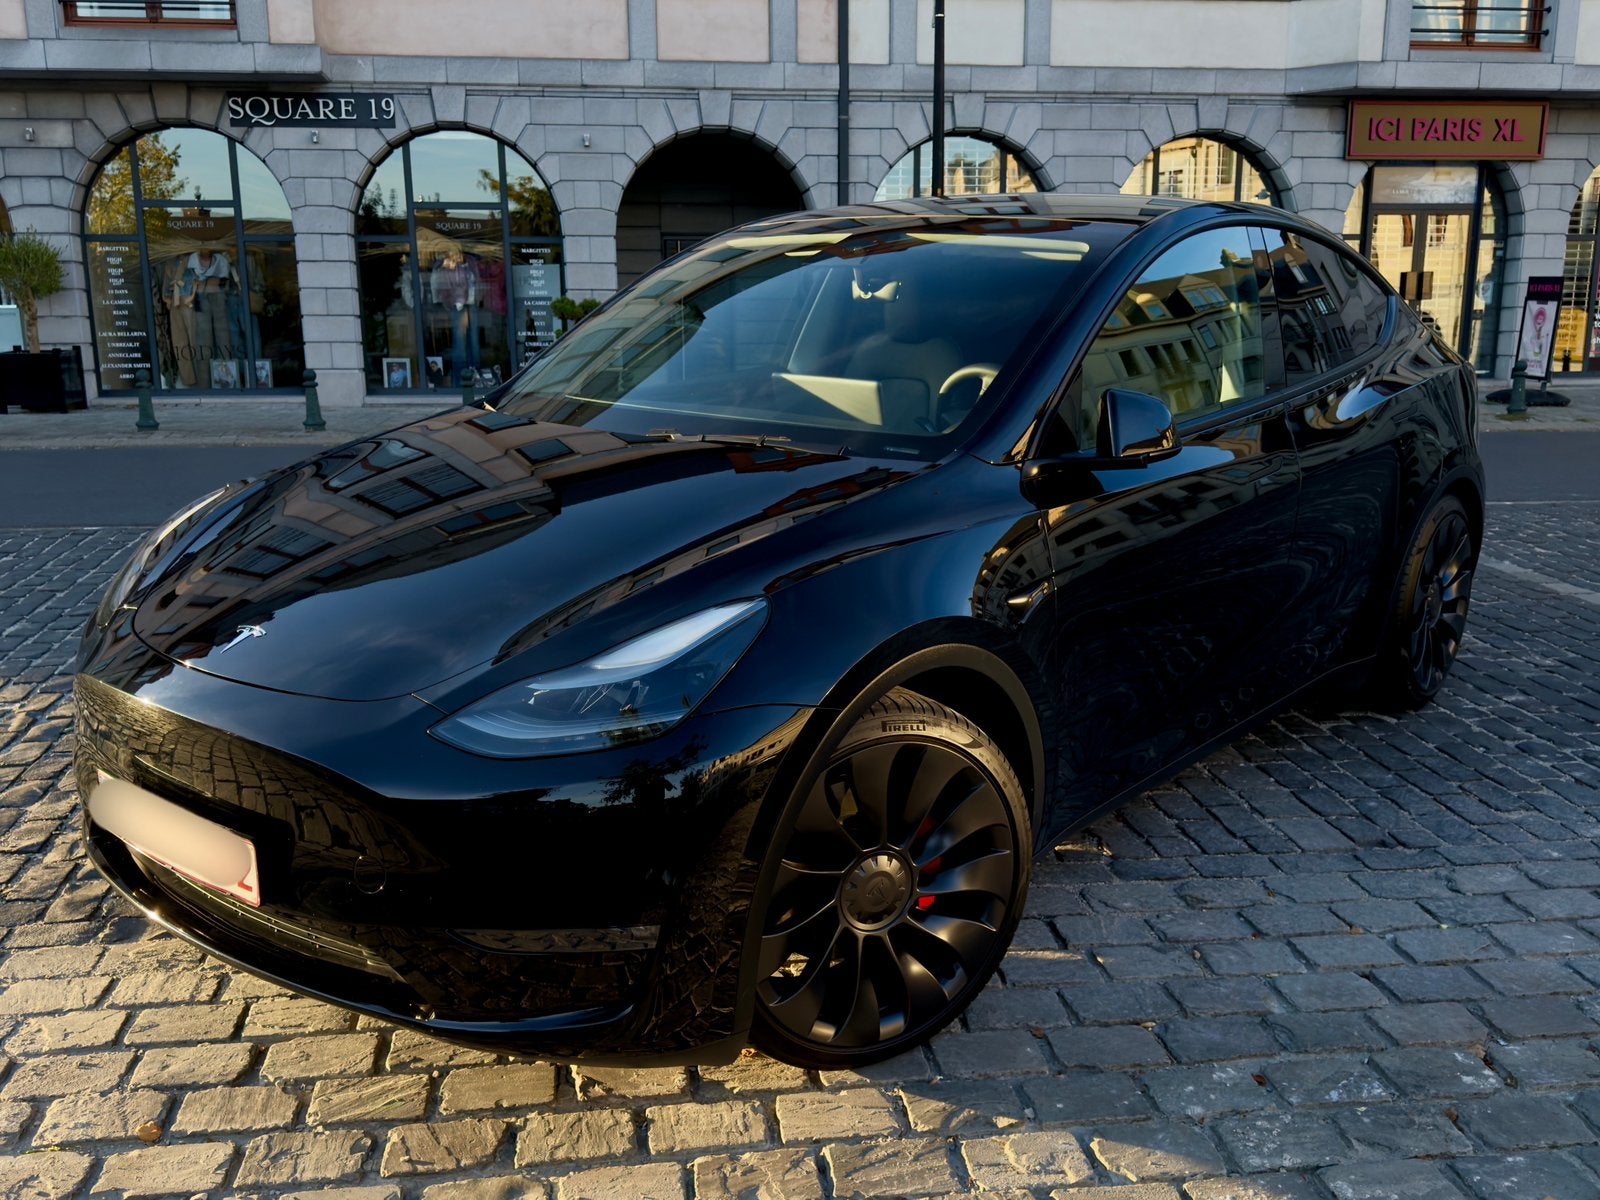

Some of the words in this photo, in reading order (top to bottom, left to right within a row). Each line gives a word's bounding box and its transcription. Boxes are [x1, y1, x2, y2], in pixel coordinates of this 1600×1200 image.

[228, 96, 357, 126] SQUARE
[368, 97, 395, 120] 19
[1368, 117, 1404, 142] ICI
[1411, 117, 1484, 142] PARIS
[1492, 117, 1525, 142] XL
[167, 220, 203, 230] SQUARE
[205, 220, 214, 228] 19
[435, 222, 471, 231] SQUARE
[473, 222, 482, 230] 19
[881, 719, 926, 732] PIRELLI
